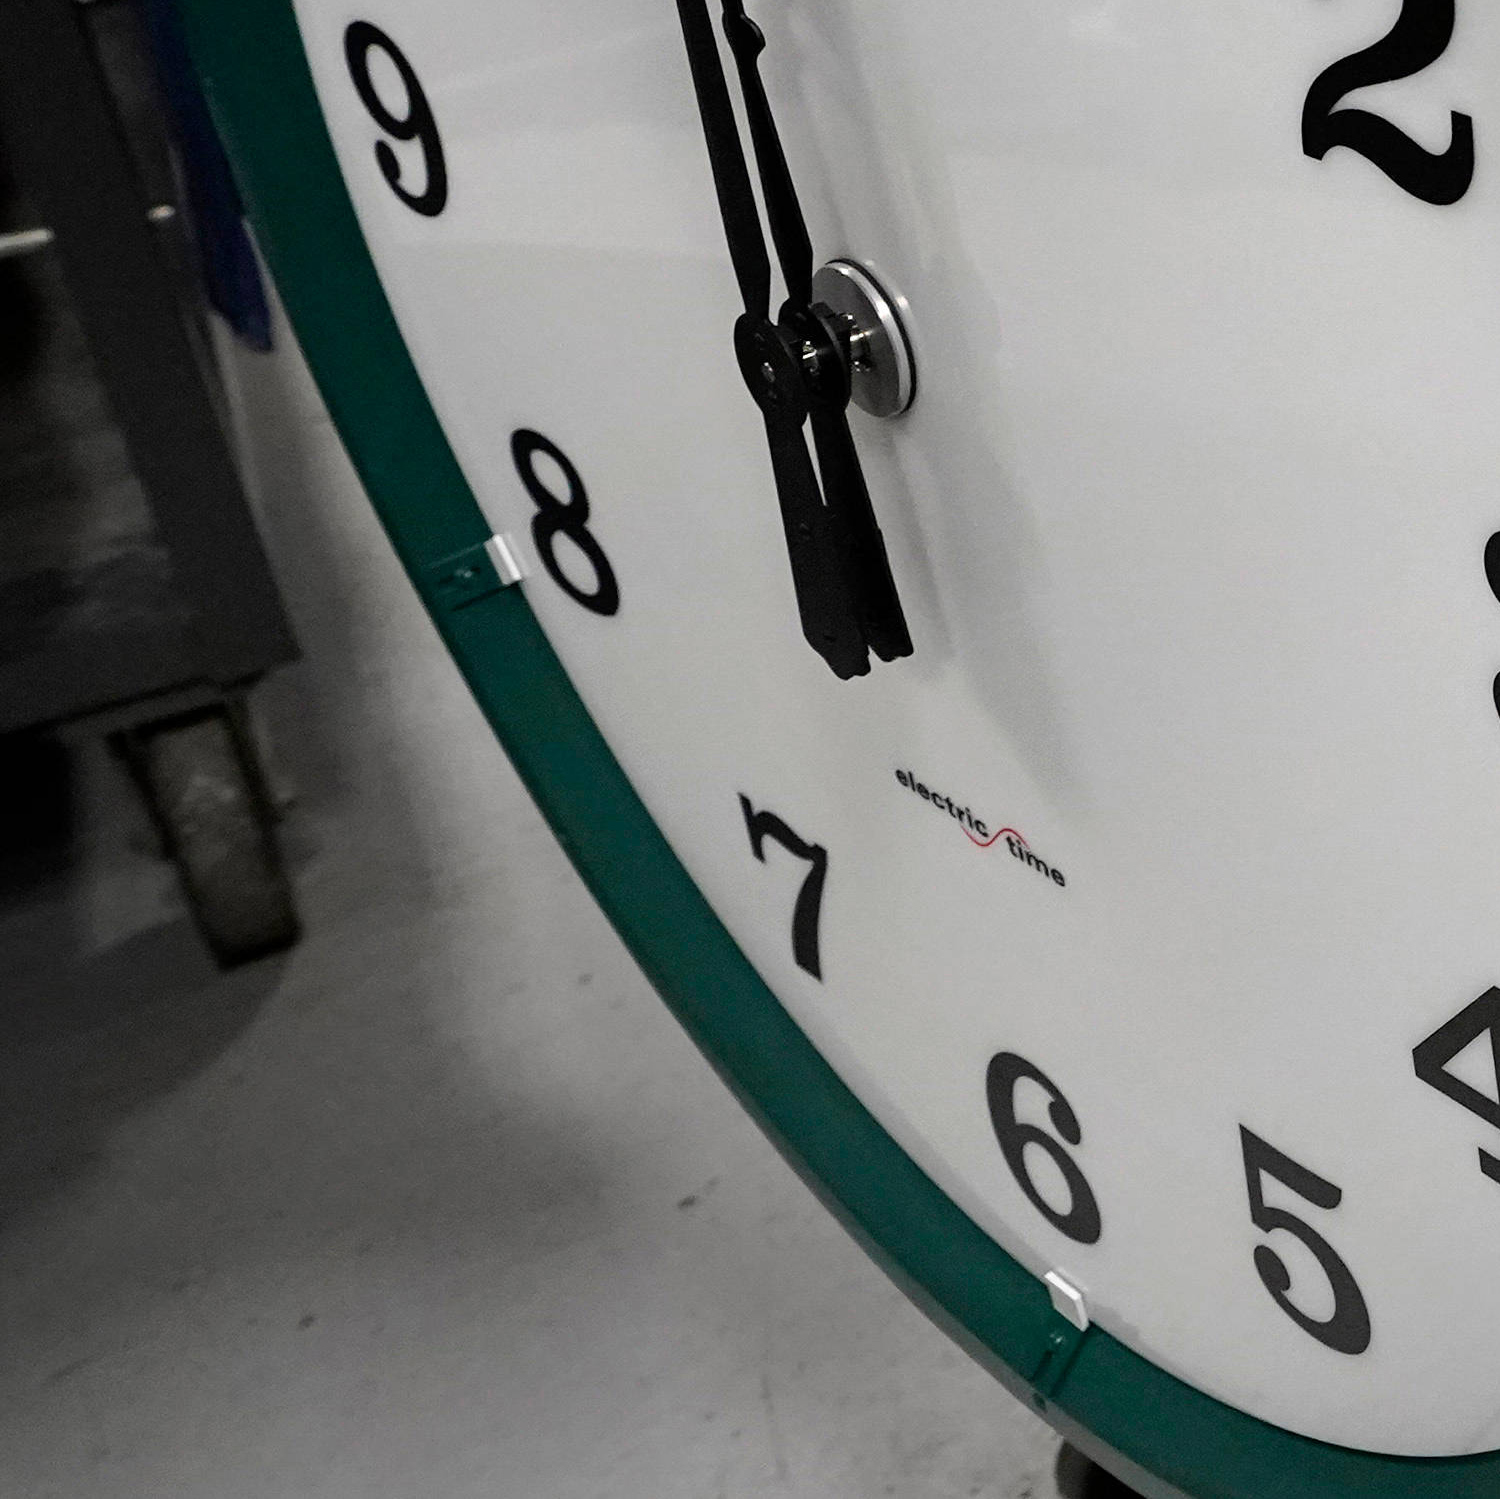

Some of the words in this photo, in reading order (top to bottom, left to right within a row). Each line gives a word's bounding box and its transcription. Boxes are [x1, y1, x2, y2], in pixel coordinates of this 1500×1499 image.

[342, 19, 449, 218] 9
[509, 427, 621, 618] 8
[737, 792, 829, 982] 7
[895, 768, 989, 837] electric
[1006, 835, 1065, 887] time
[985, 1051, 1102, 1245] 6
[1238, 1123, 1372, 1356] 5
